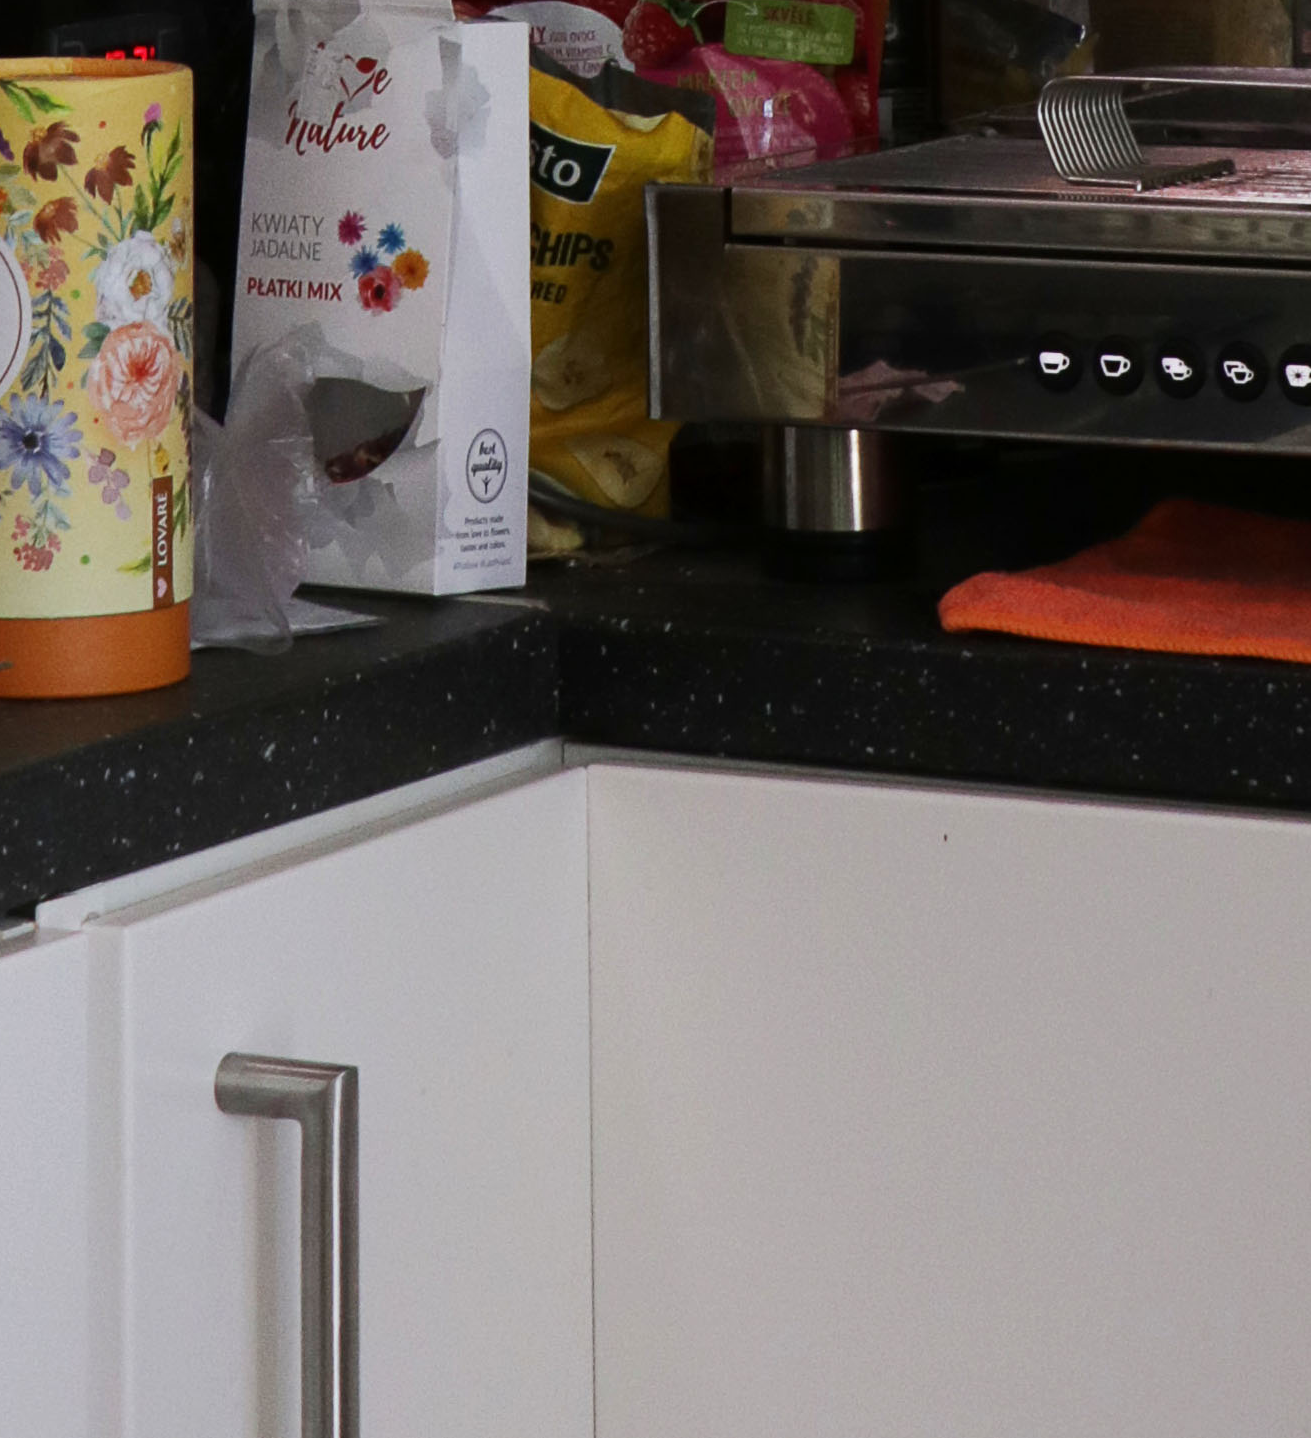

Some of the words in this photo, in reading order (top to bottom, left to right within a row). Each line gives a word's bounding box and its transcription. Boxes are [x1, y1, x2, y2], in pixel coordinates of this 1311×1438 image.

[251, 212, 325, 236] KWIATY
[249, 239, 322, 261] JADALNE
[247, 276, 302, 298] PŁATKI
[308, 280, 342, 302] MIX
[155, 492, 168, 566] LOVARÉ
